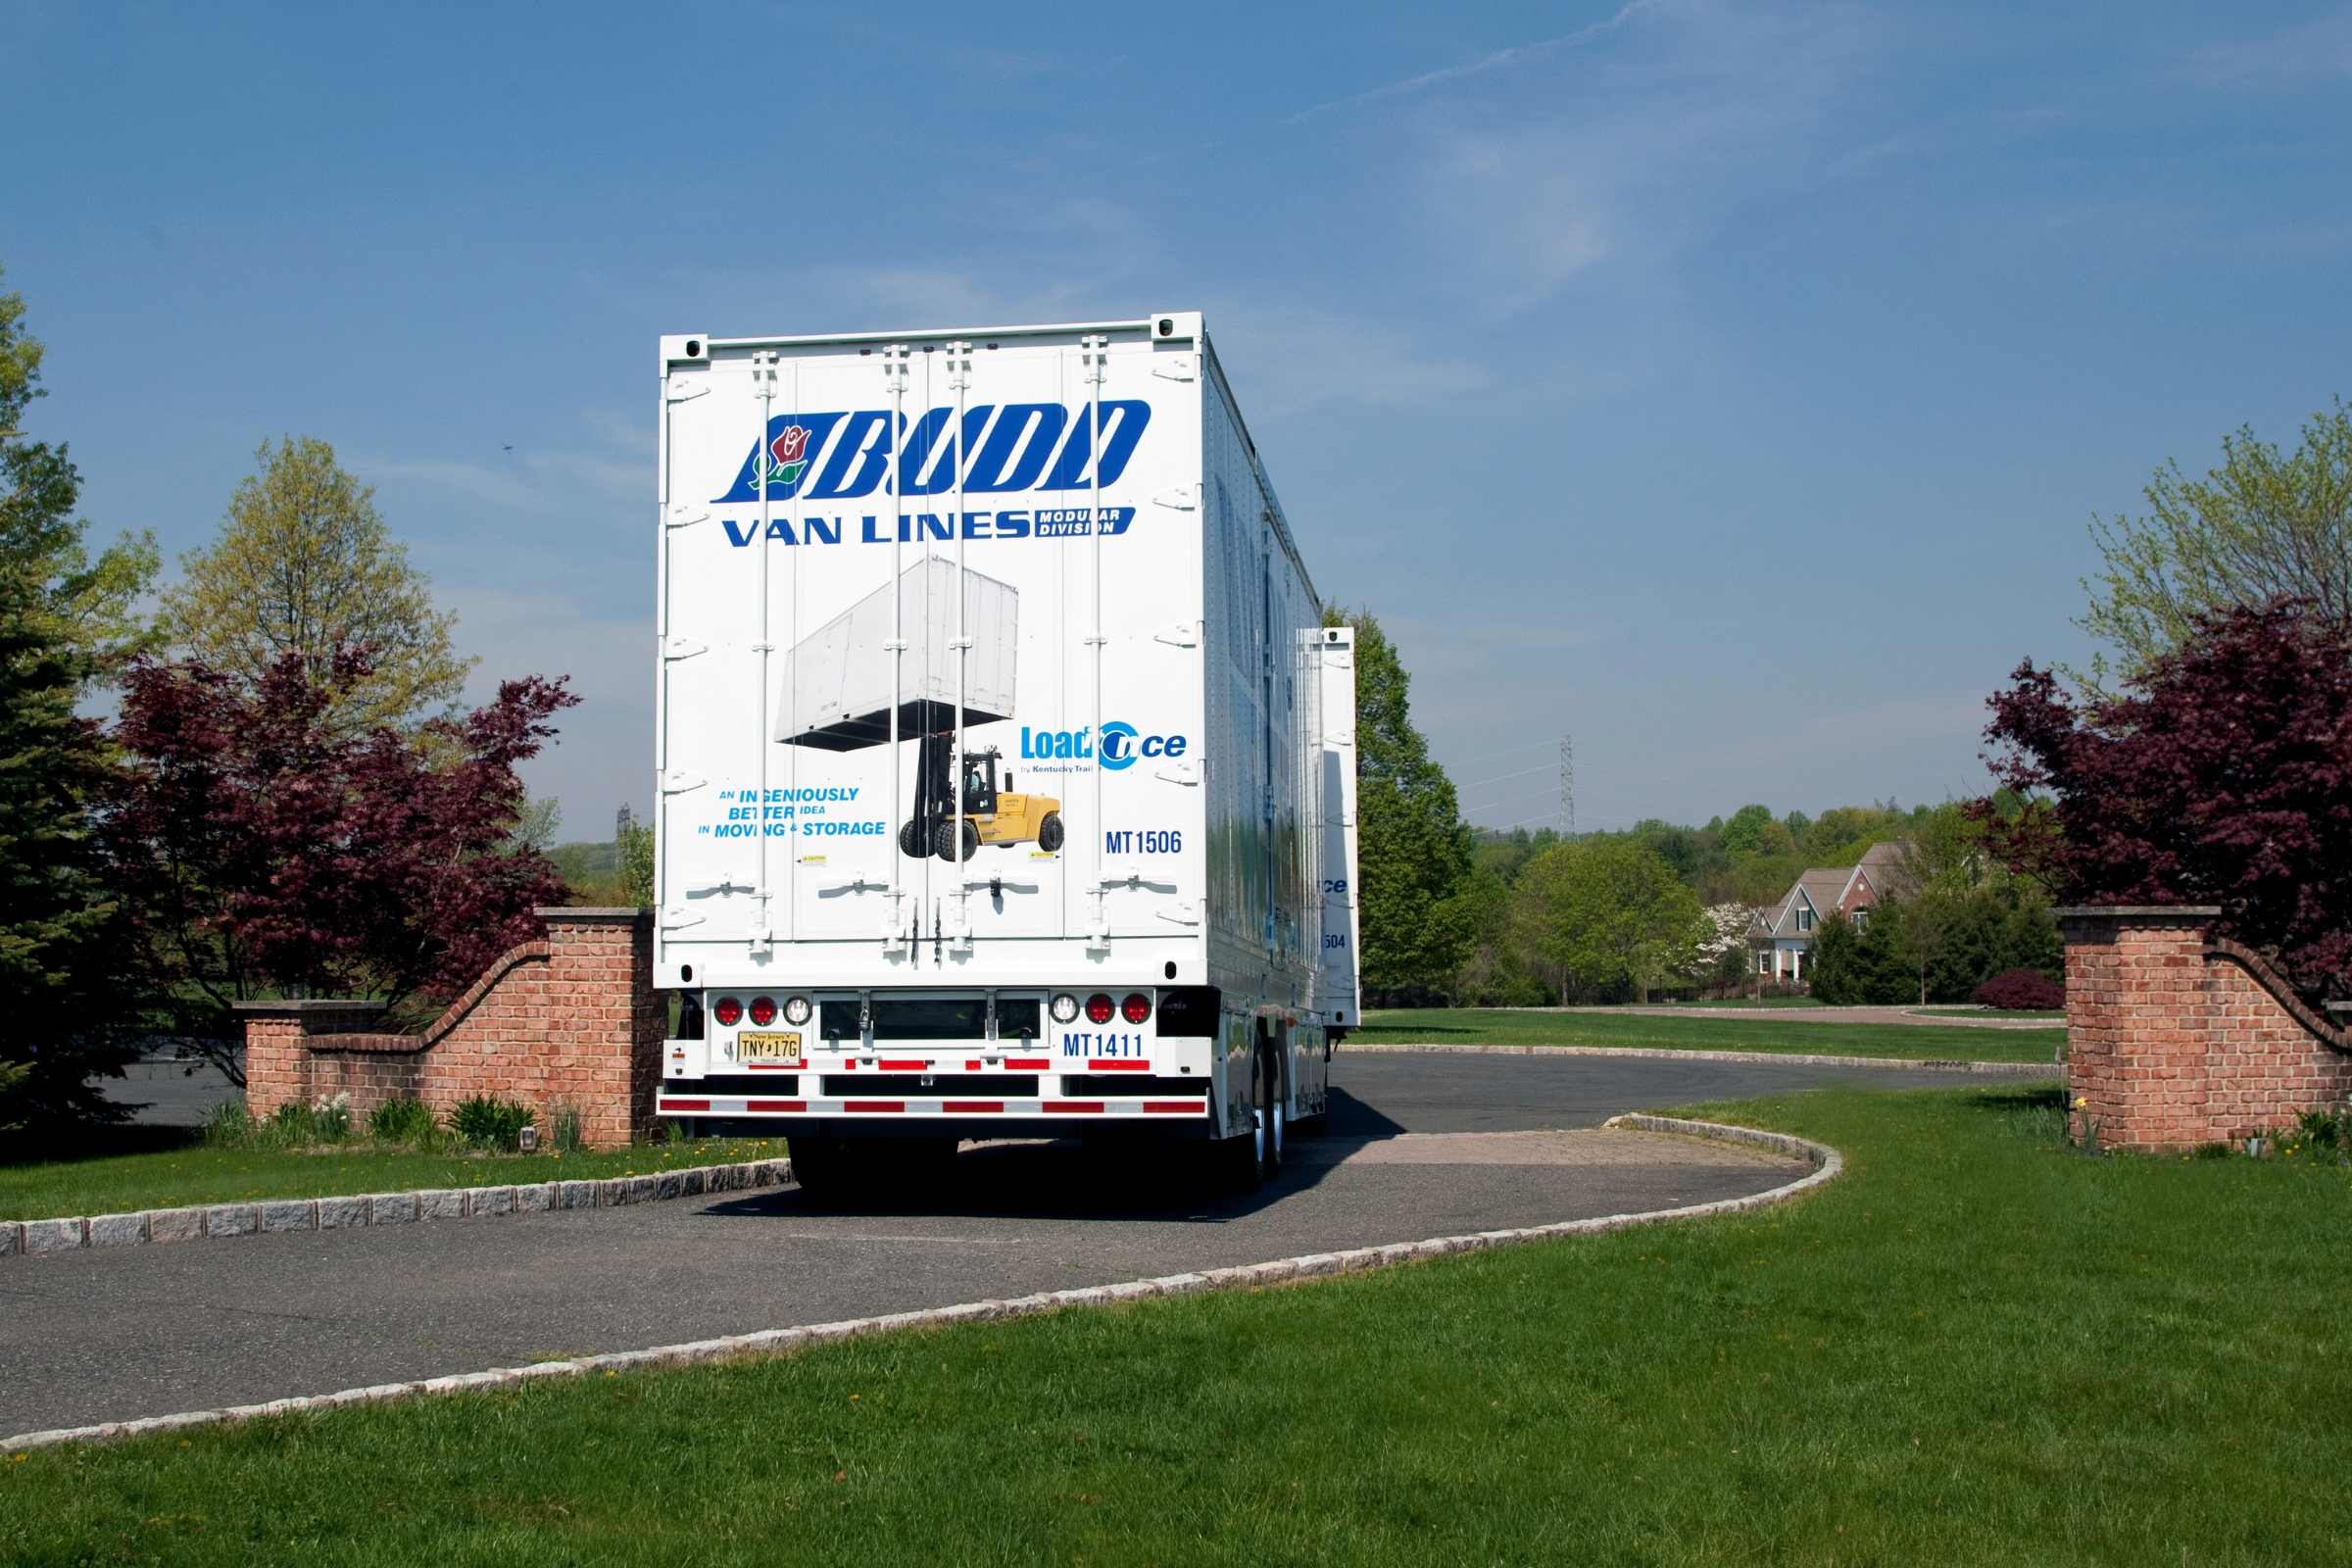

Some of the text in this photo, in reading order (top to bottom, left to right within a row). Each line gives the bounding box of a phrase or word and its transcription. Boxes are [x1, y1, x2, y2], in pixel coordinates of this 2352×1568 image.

[802, 399, 1152, 500] BUDD
[1039, 509, 1120, 523] MODUAR
[721, 511, 1031, 548] VAN LINES
[1039, 521, 1115, 536] DIVISIN
[1032, 765, 1074, 774] Kentucky
[719, 787, 860, 803] AN INGENIOUSLY
[800, 806, 826, 815] IDEA
[698, 825, 710, 834] IN
[803, 821, 886, 836] STORAGE
[742, 1040, 764, 1057] TNY
